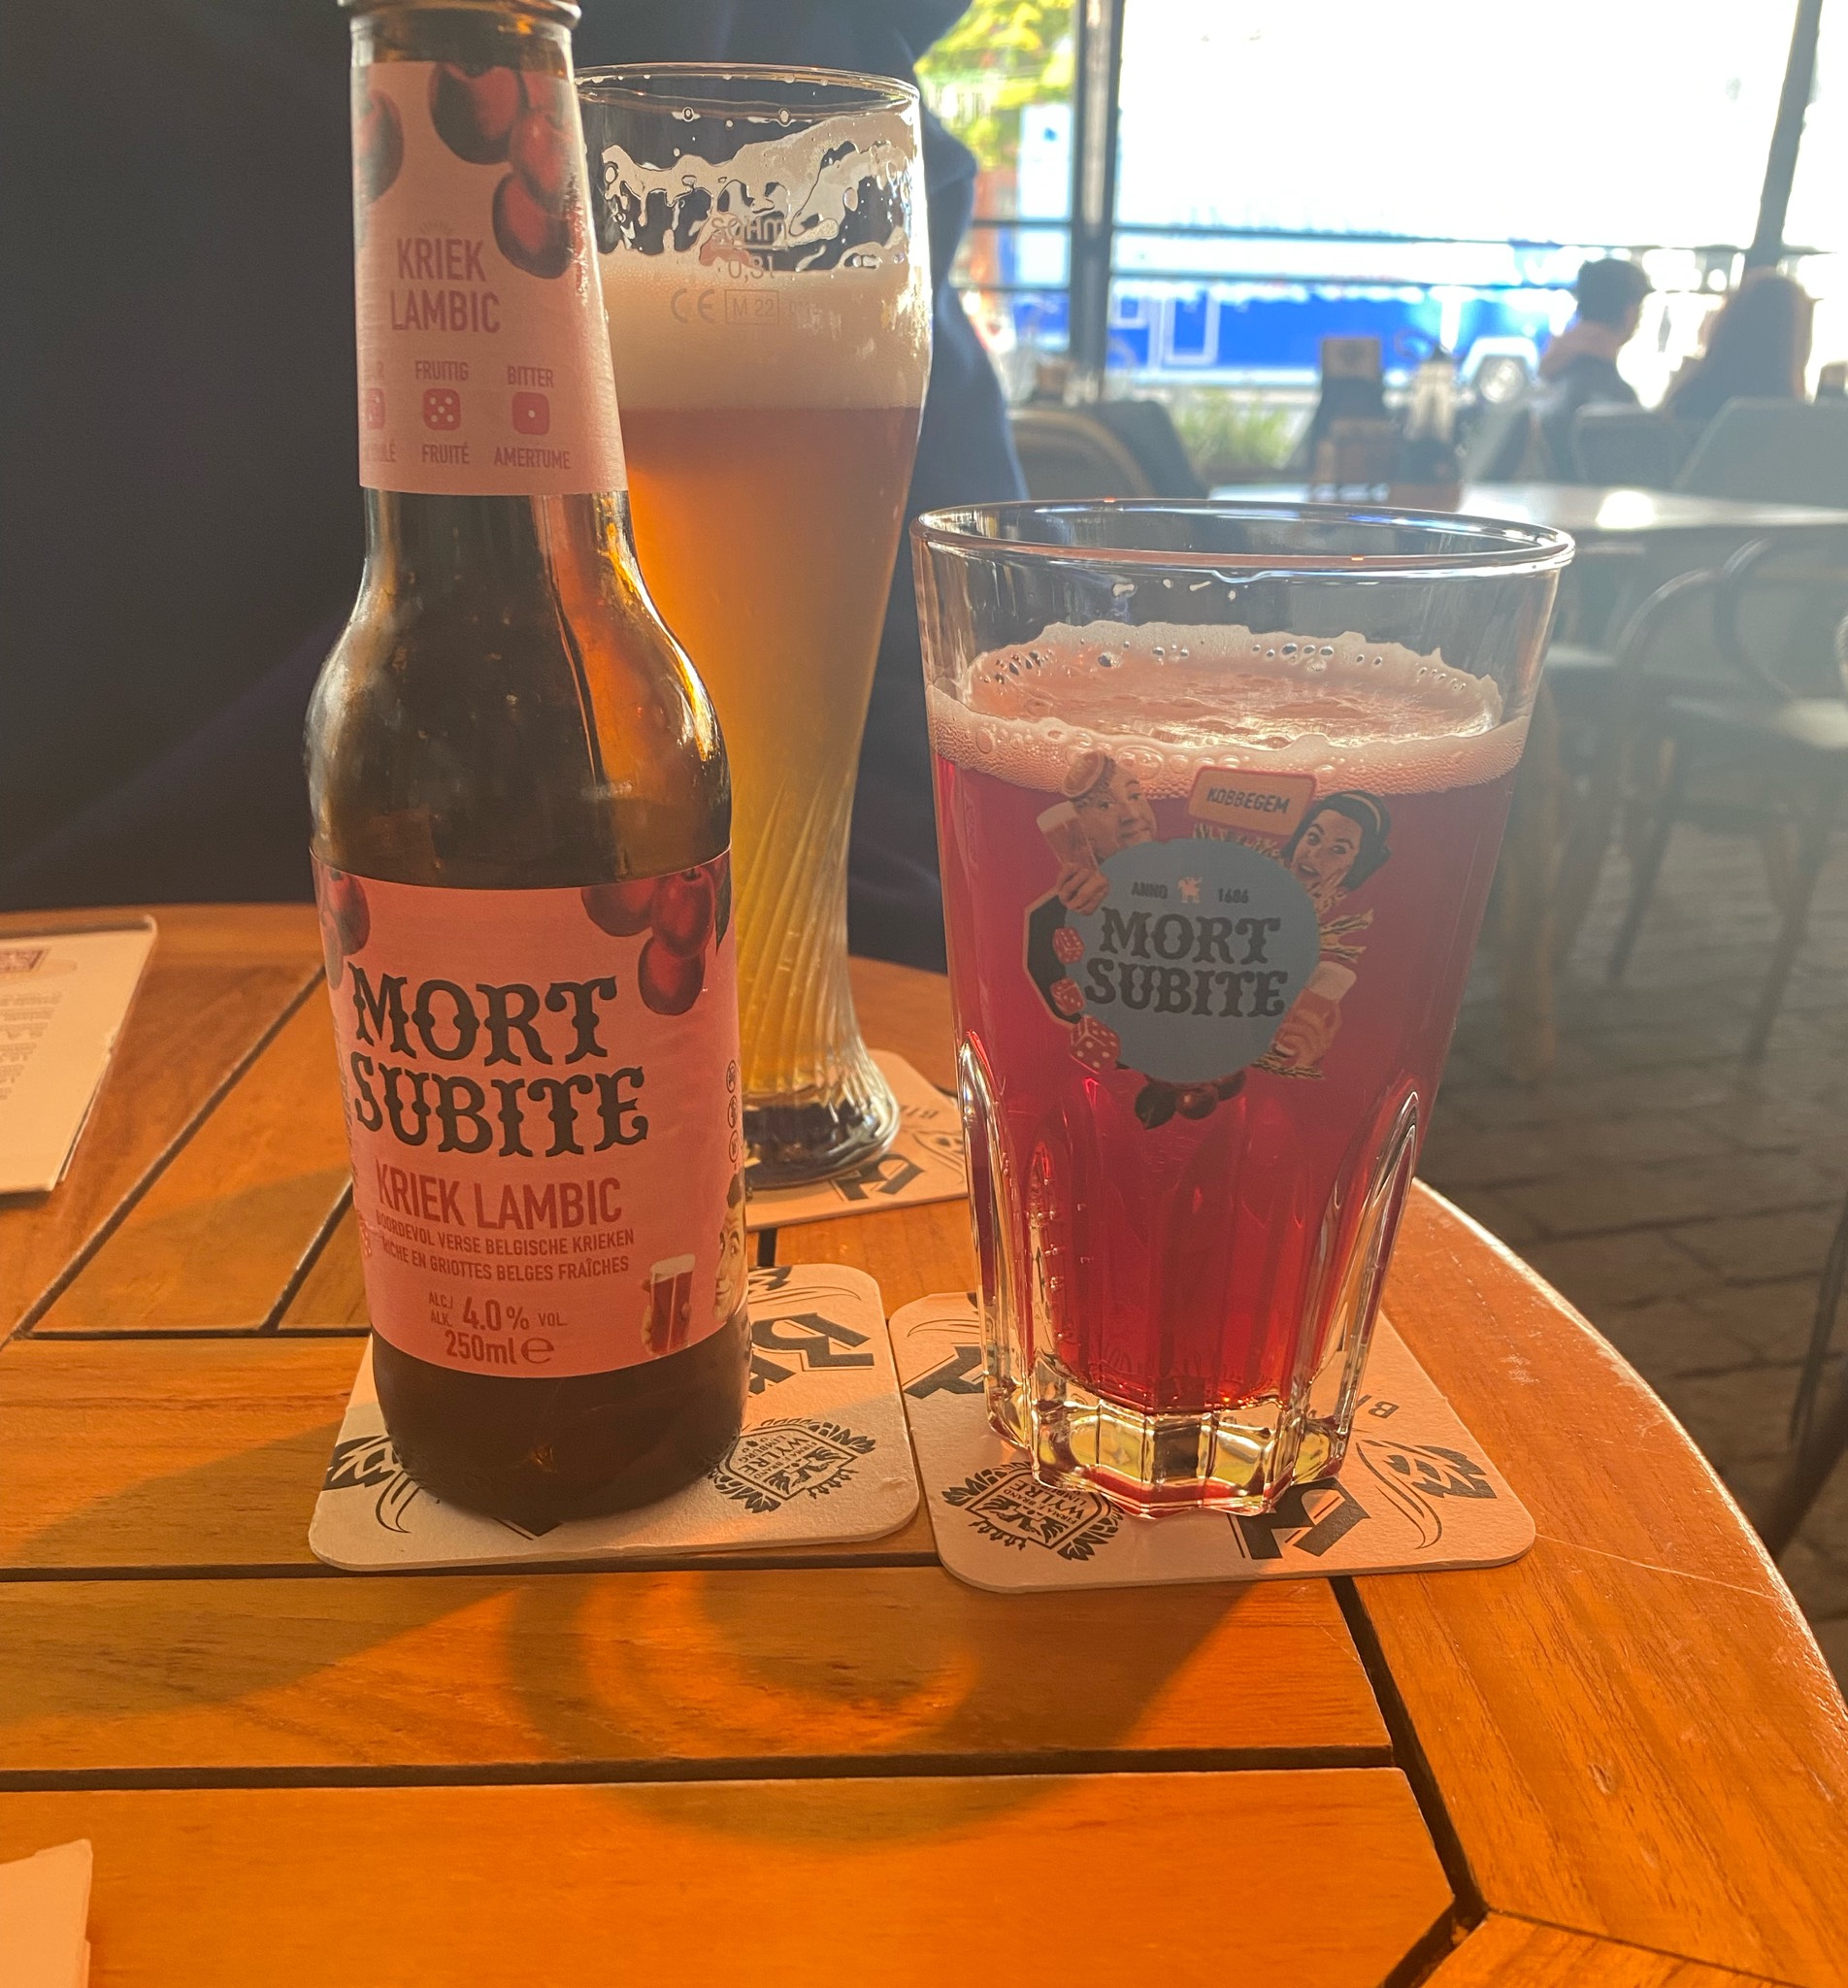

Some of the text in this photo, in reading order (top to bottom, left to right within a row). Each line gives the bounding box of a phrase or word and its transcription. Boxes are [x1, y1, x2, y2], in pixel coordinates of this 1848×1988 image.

[396, 238, 485, 282] KRIEK
[389, 289, 501, 333] LAMBIC
[415, 360, 469, 381] FRUITIG
[508, 366, 554, 387] BITTER
[421, 440, 471, 464] FRUITÉ
[493, 447, 571, 469] AMERTUME
[1206, 787, 1290, 813] KOBBEGEM
[1131, 881, 1250, 904] ANNO 1686
[1099, 907, 1281, 965] MORT
[1084, 957, 1289, 1017] SUBITE
[347, 961, 617, 1066] MORT
[350, 1051, 649, 1157] SUBITE
[376, 1158, 622, 1230] KRIEK LAMBIC
[437, 1231, 480, 1253] VERSE
[485, 1238, 568, 1256] BELGISCHE
[572, 1228, 634, 1253] KRIEKEN
[412, 1250, 427, 1270] EN
[429, 1255, 492, 1280] GRIOTTES
[497, 1264, 553, 1281] BELGES
[558, 1255, 629, 1279] FRAÎCHES
[738, 1435, 787, 1463] LIMBURG
[738, 1438, 809, 1475] WYLRE
[753, 1461, 784, 1479] BRAND
[1003, 1488, 1038, 1506] BRAND
[1009, 1479, 1085, 1520] WYLRE
